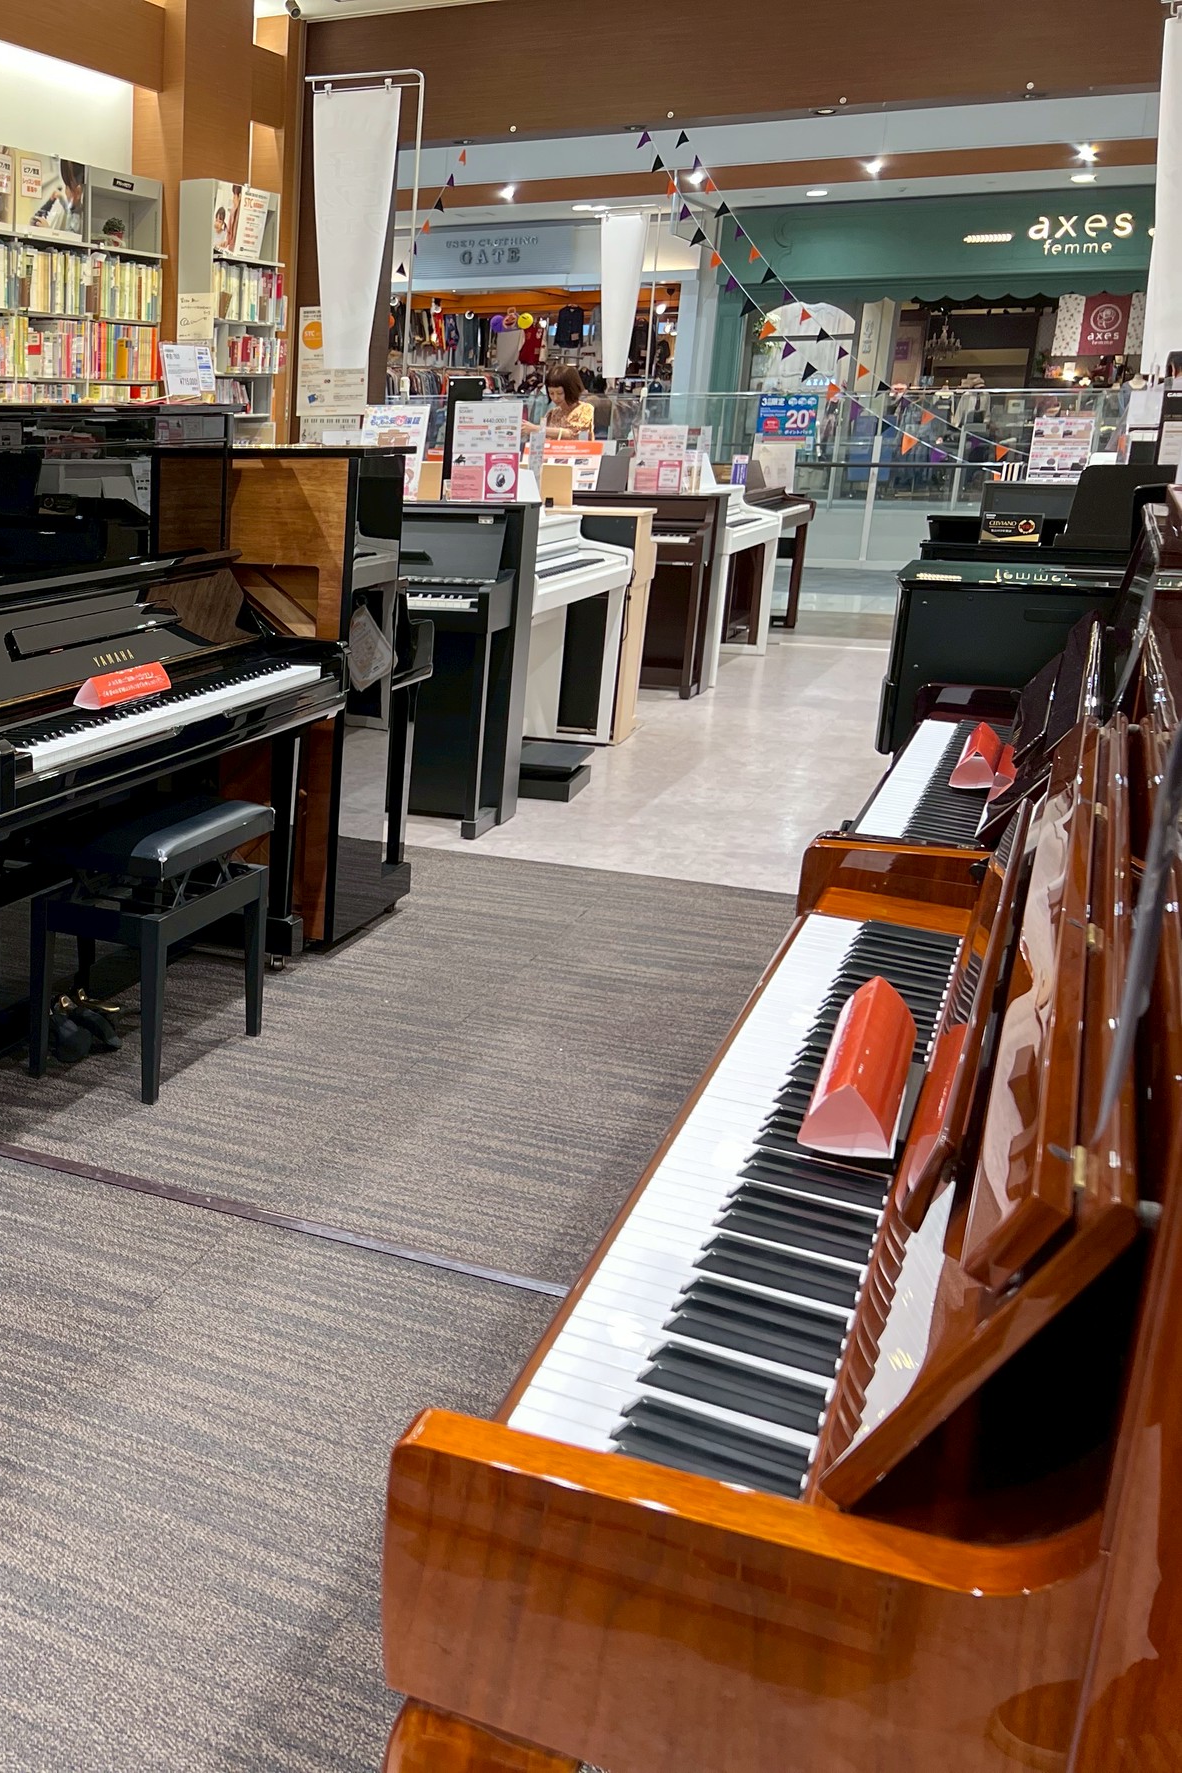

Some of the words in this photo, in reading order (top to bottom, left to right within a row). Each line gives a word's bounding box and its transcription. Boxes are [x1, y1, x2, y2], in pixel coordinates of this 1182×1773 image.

[1028, 212, 1134, 240] axes
[459, 247, 521, 266] GATE
[1043, 239, 1113, 256] femme
[1087, 331, 1120, 341] axes
[92, 648, 135, 668] YAMAHA
